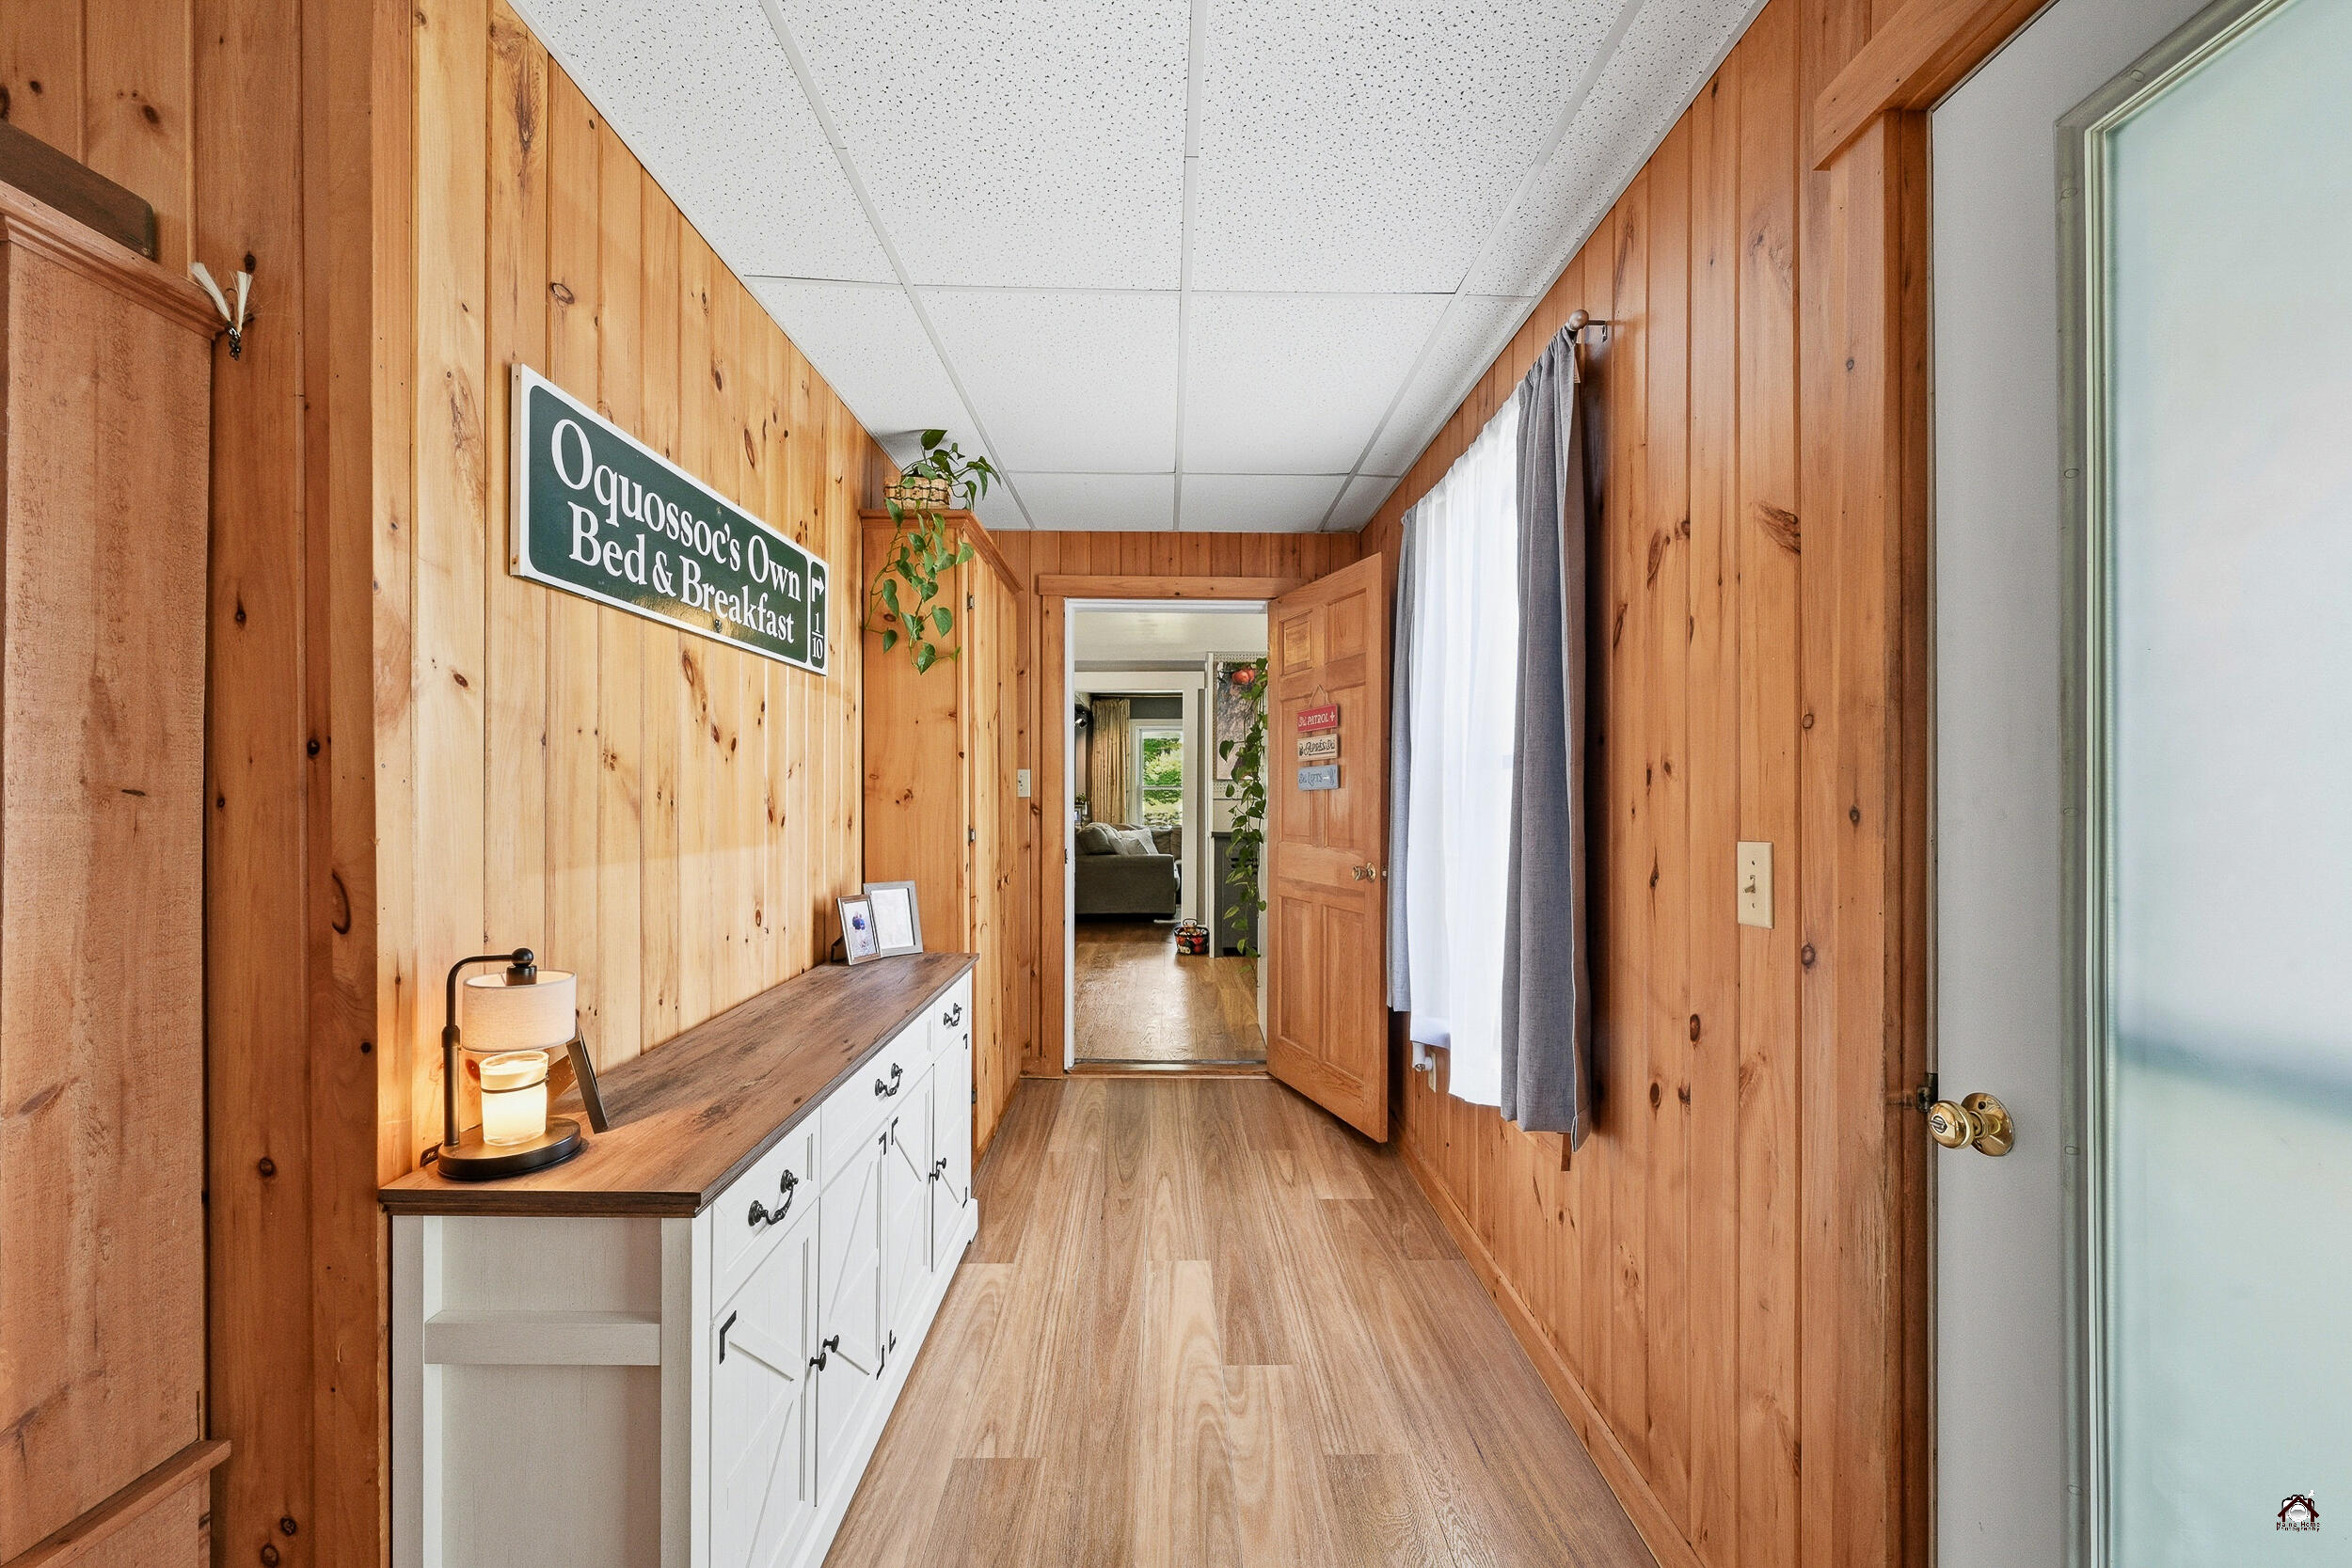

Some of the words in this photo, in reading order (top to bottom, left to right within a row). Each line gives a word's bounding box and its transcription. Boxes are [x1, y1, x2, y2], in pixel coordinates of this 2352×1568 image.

[551, 419, 741, 571] Oquossoc's
[748, 535, 802, 603] Own
[567, 500, 647, 585] Bed
[652, 550, 676, 598] &
[678, 555, 795, 644] Breakfast
[1308, 713, 1328, 725] PATROL
